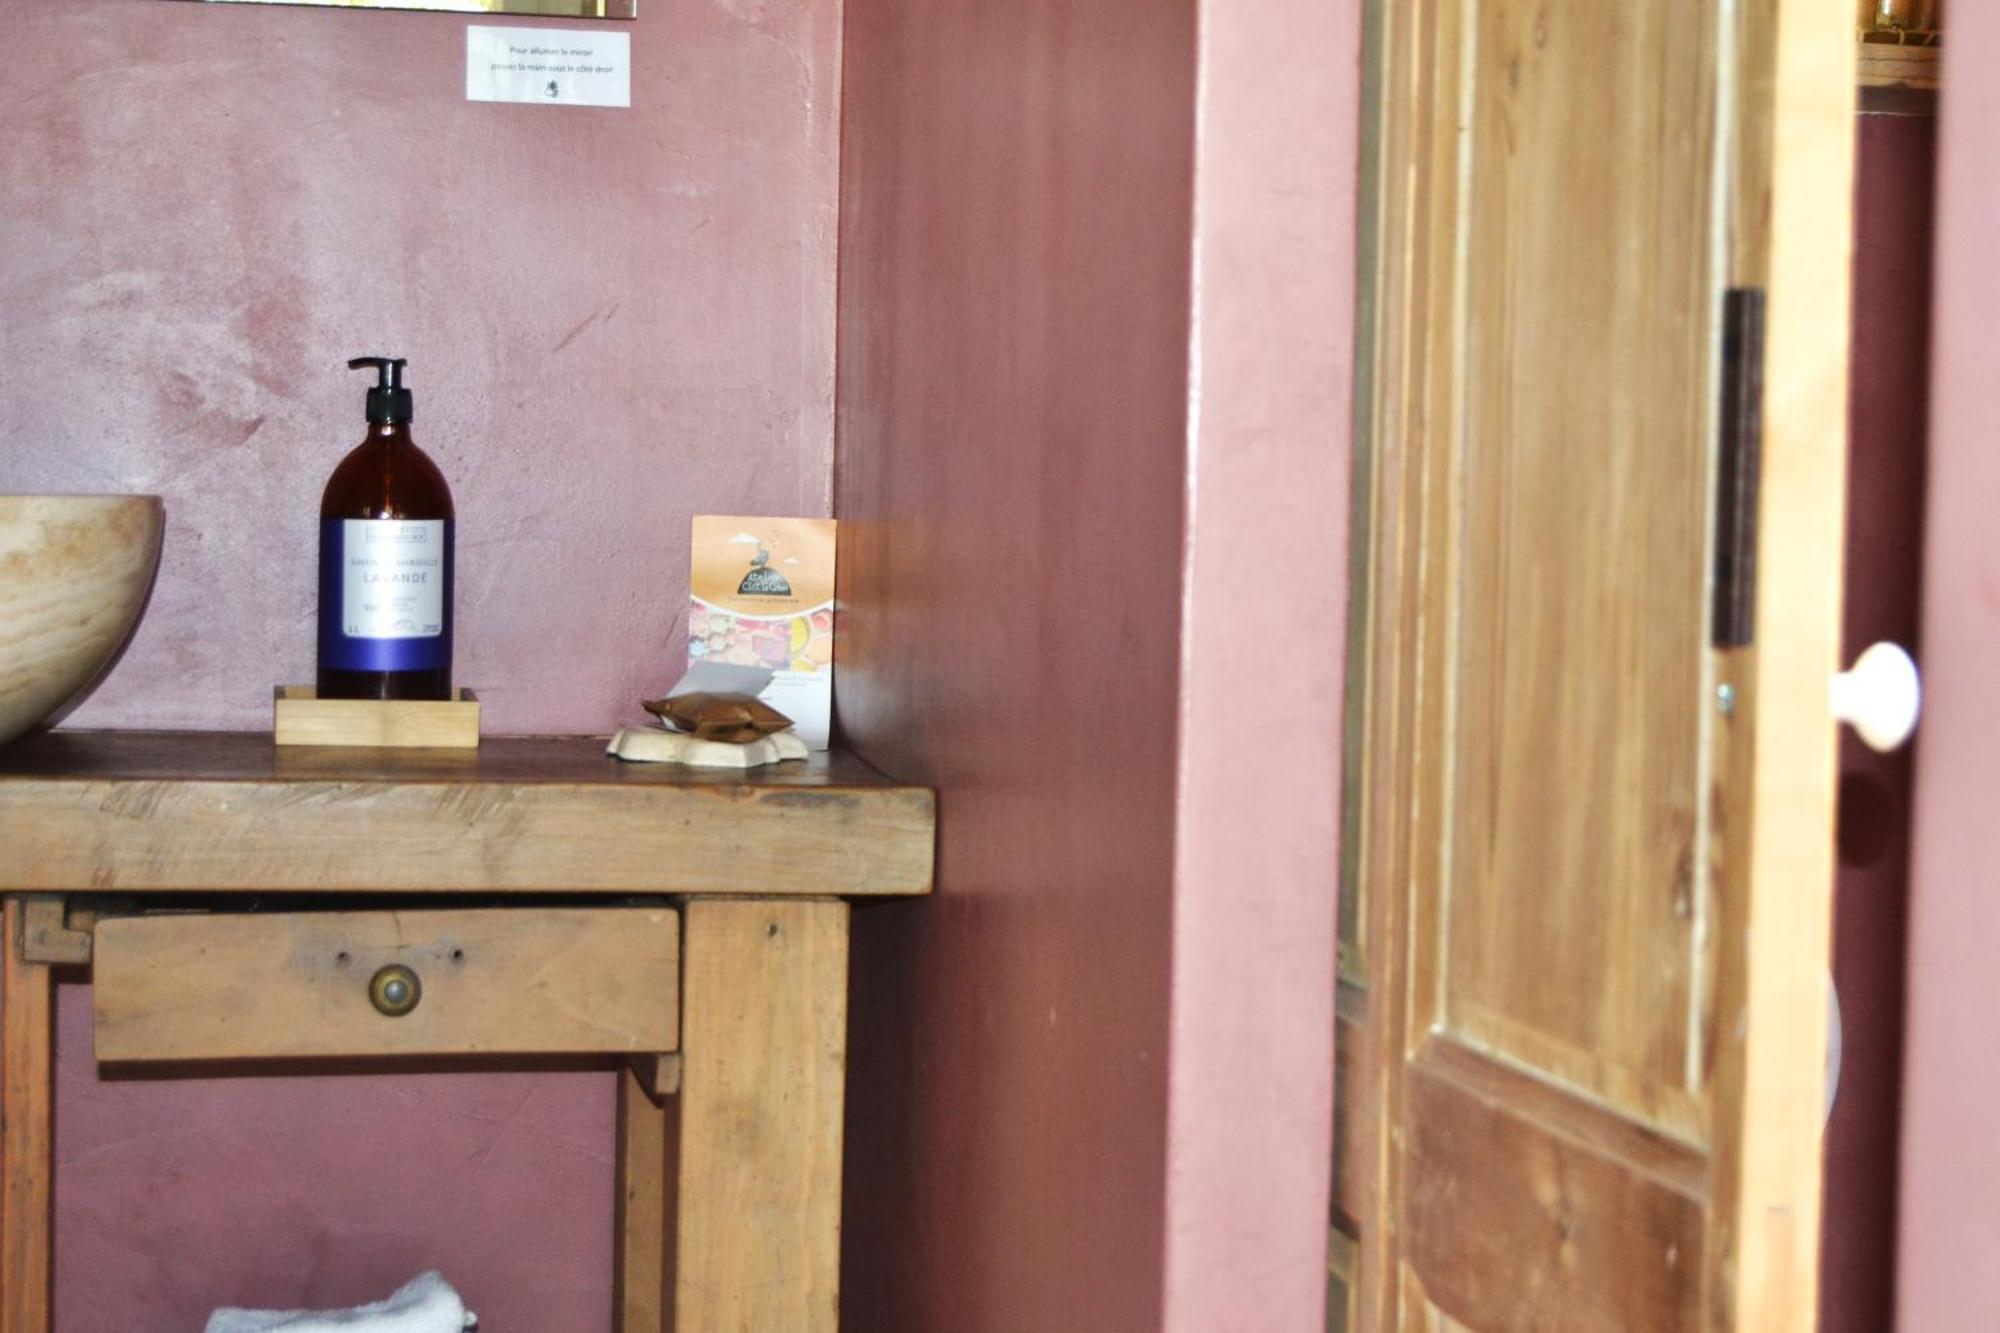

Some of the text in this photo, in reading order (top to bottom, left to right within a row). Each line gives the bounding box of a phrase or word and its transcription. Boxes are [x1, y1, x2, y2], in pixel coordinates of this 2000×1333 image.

[509, 46, 528, 55] Pour
[526, 64, 546, 72] main
[363, 572, 428, 584] LAVANDE
